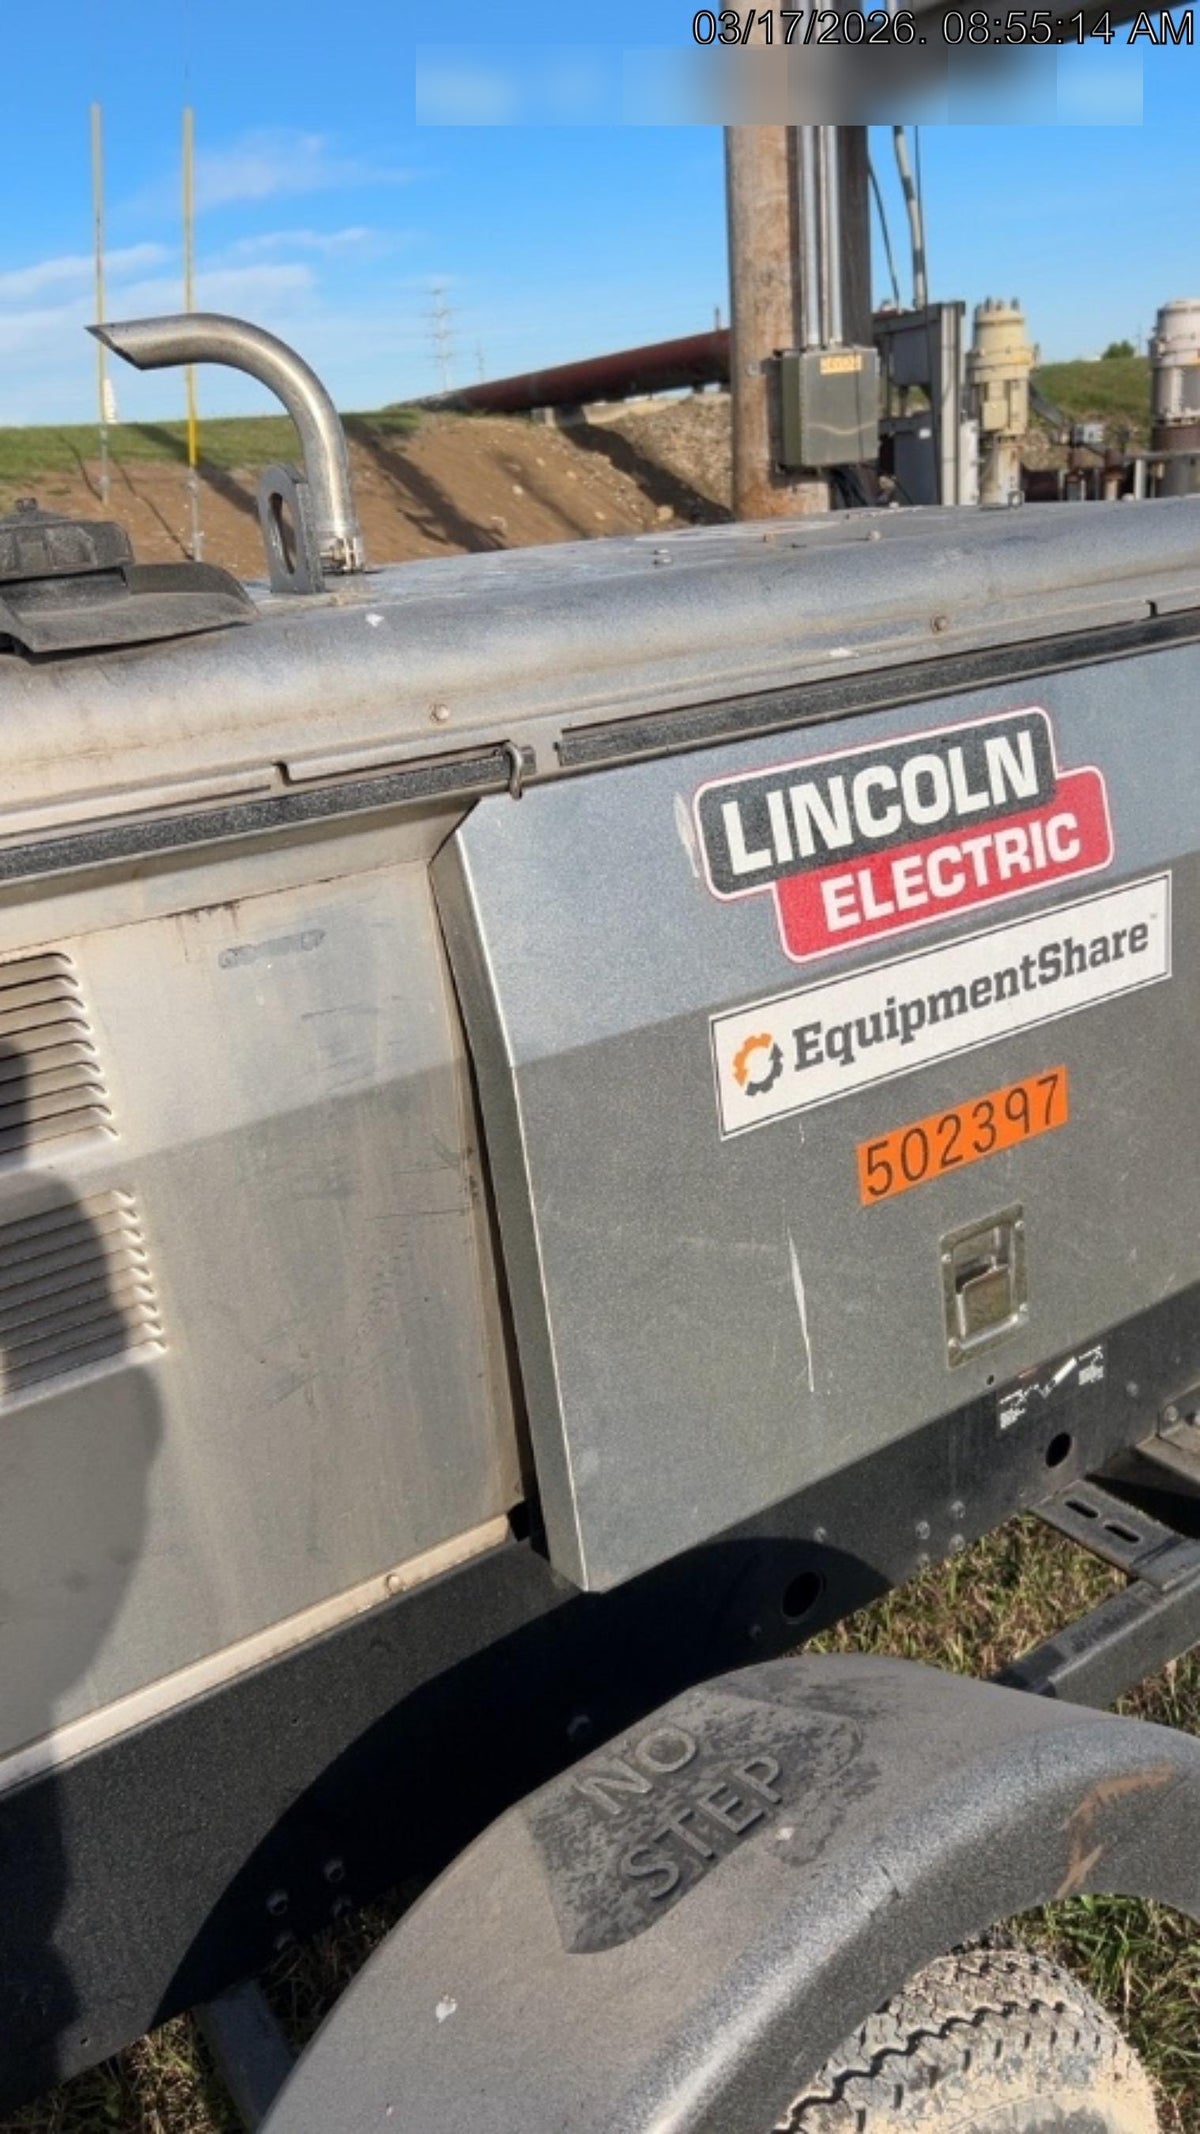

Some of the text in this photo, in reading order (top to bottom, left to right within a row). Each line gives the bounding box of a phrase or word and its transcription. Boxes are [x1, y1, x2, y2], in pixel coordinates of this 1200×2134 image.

[721, 731, 1040, 876] LINCOLN
[822, 812, 1081, 933] ELECTRIC
[792, 922, 1150, 1072] EquipmentShare
[866, 1075, 1059, 1197] 502397
[577, 1728, 697, 1815] NO
[624, 1756, 782, 1899] STEP
